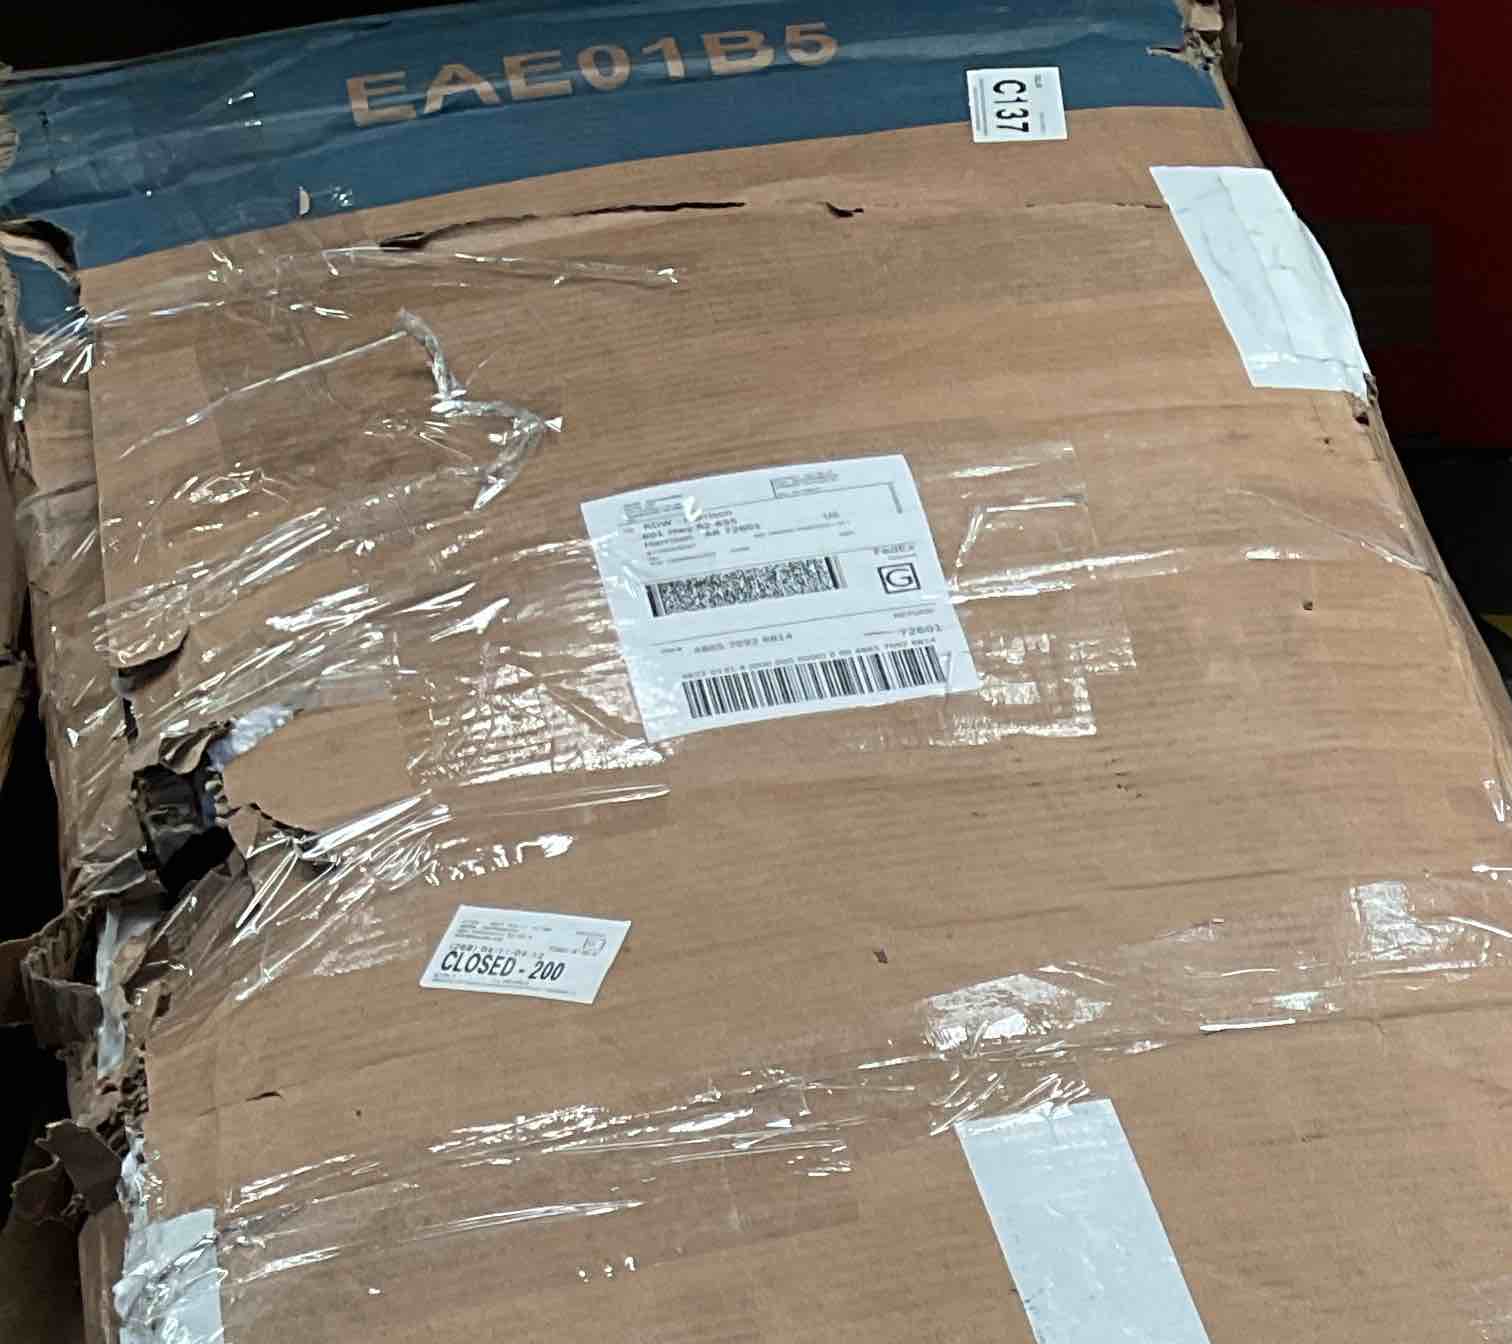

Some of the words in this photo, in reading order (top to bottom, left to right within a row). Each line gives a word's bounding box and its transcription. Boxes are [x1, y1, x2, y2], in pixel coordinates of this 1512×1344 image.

[346, 21, 839, 127] EAE01B5
[993, 80, 1030, 133] C137
[885, 567, 914, 588] G
[441, 950, 517, 977] CLOSED
[528, 960, 566, 981] 200
